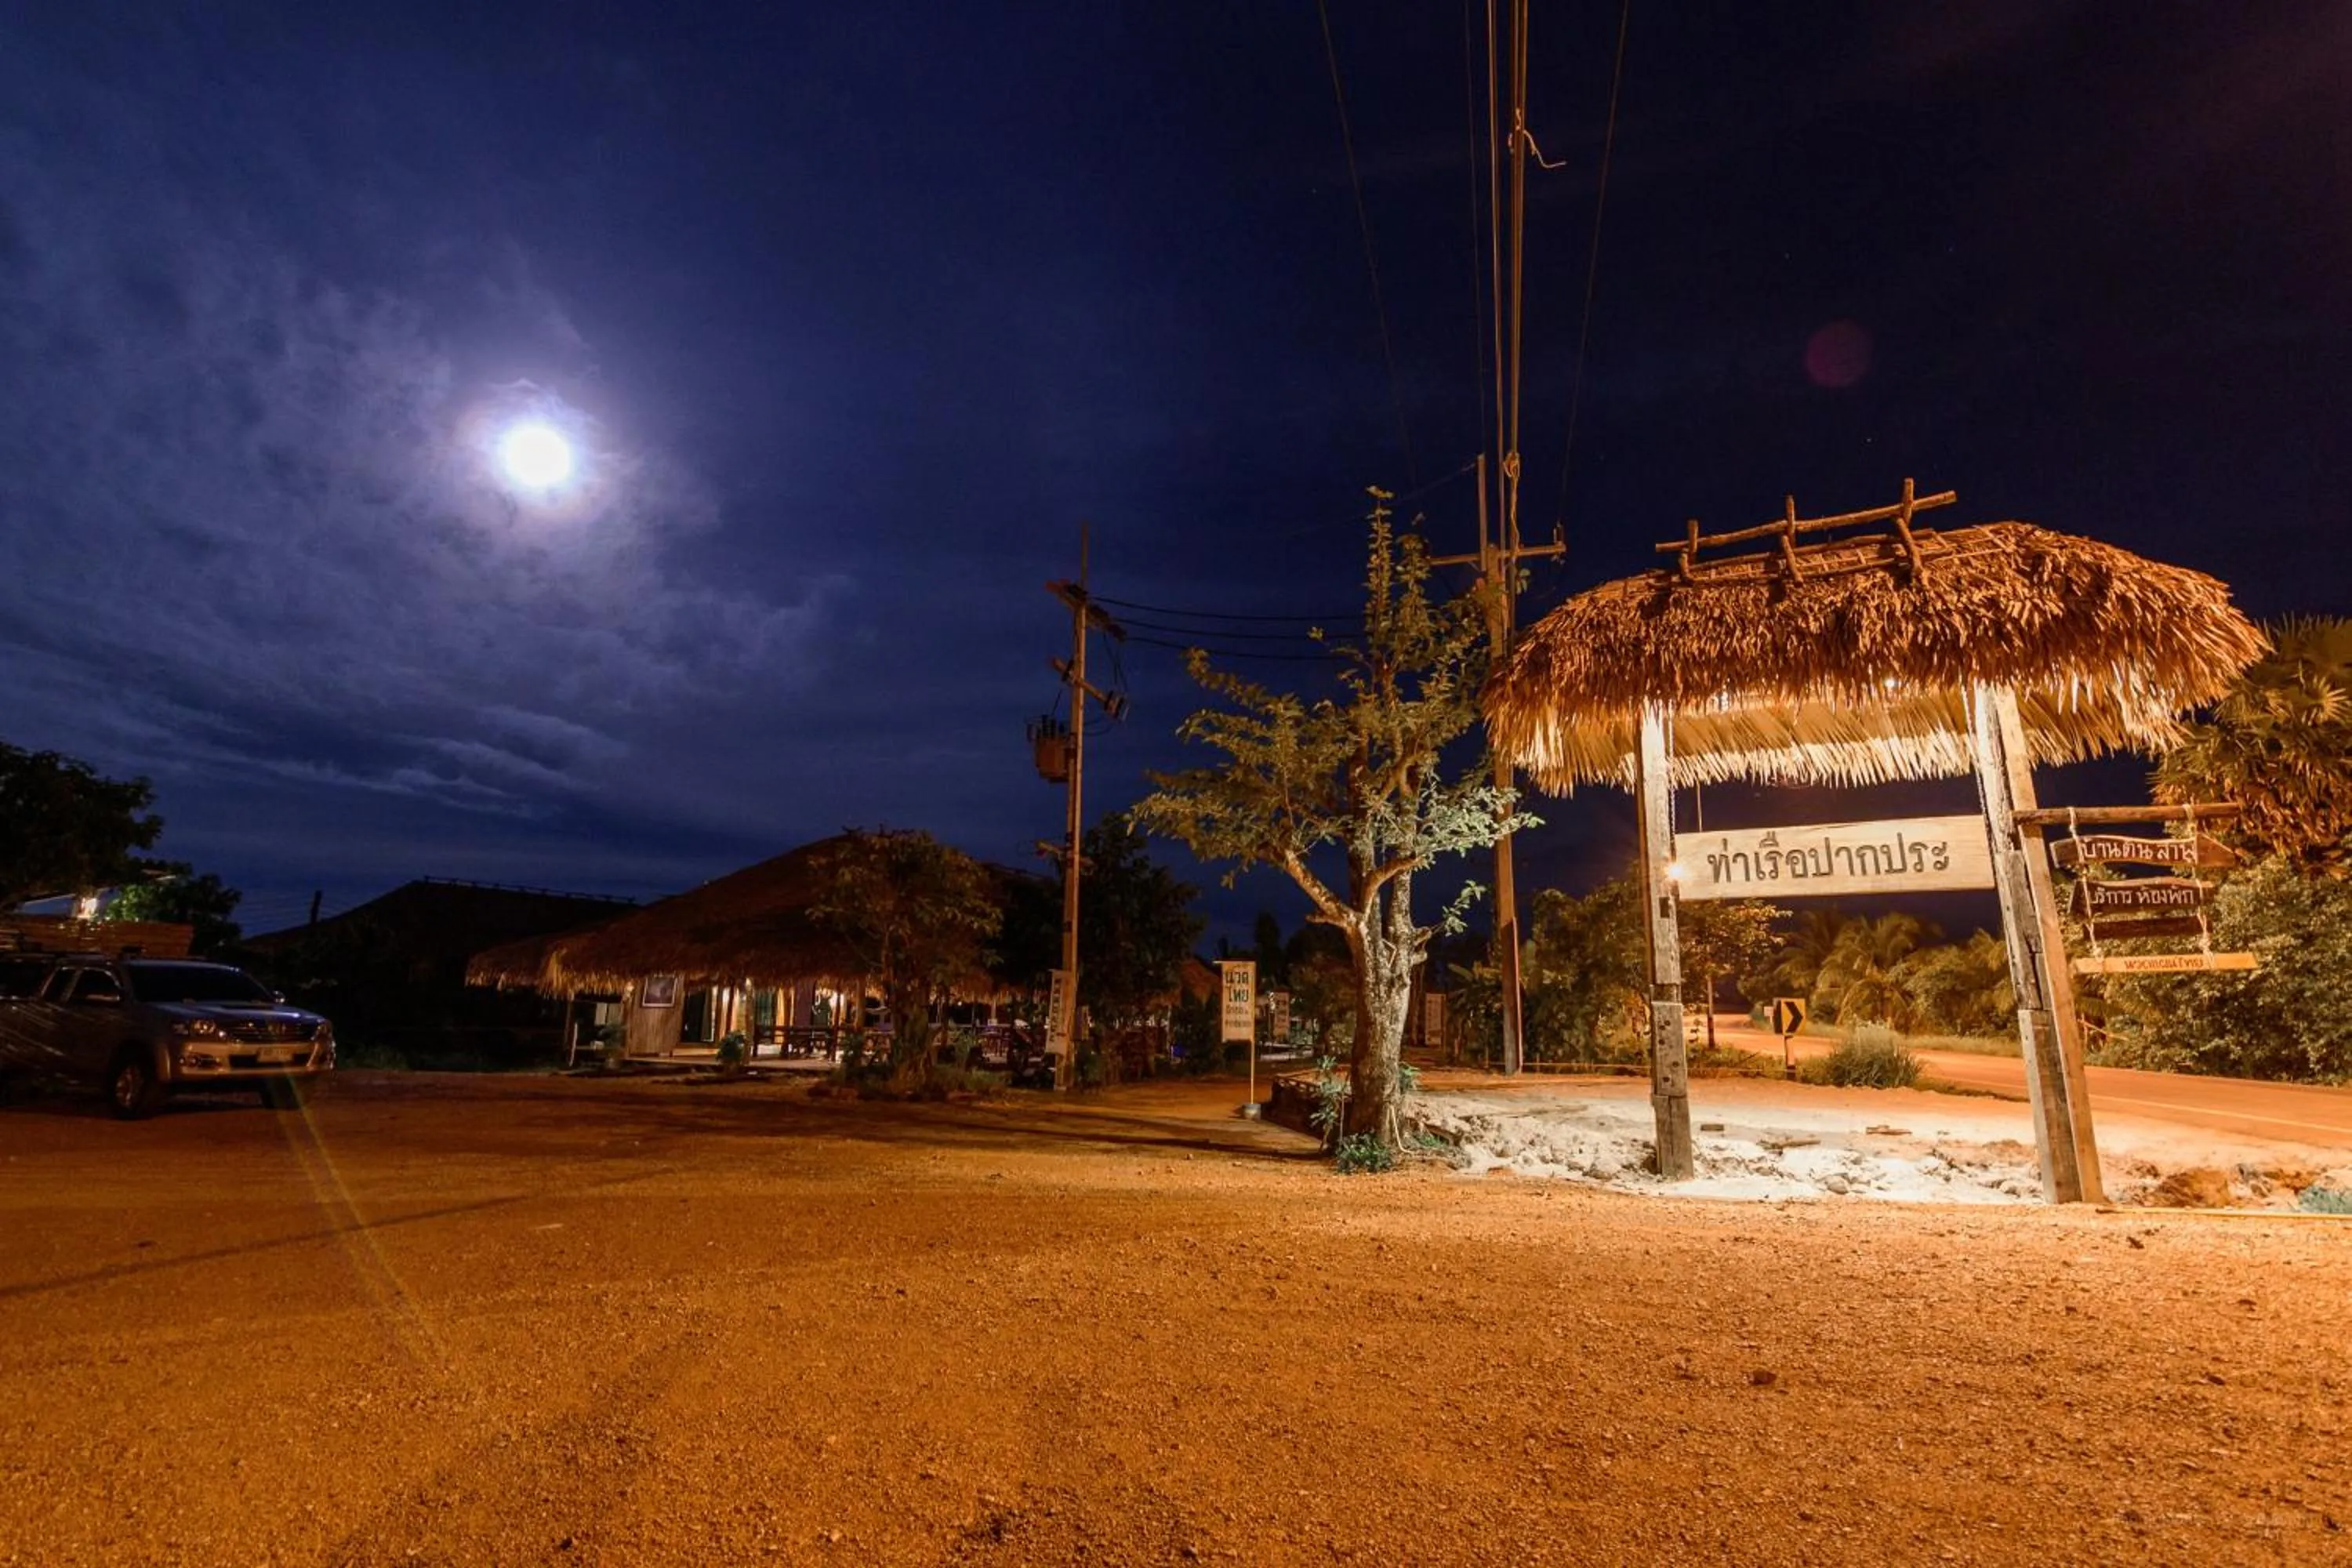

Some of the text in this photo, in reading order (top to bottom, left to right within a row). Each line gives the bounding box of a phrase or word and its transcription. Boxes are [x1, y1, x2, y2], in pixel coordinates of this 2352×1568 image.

[1707, 831, 1950, 884] ท่าเรือปากประ
